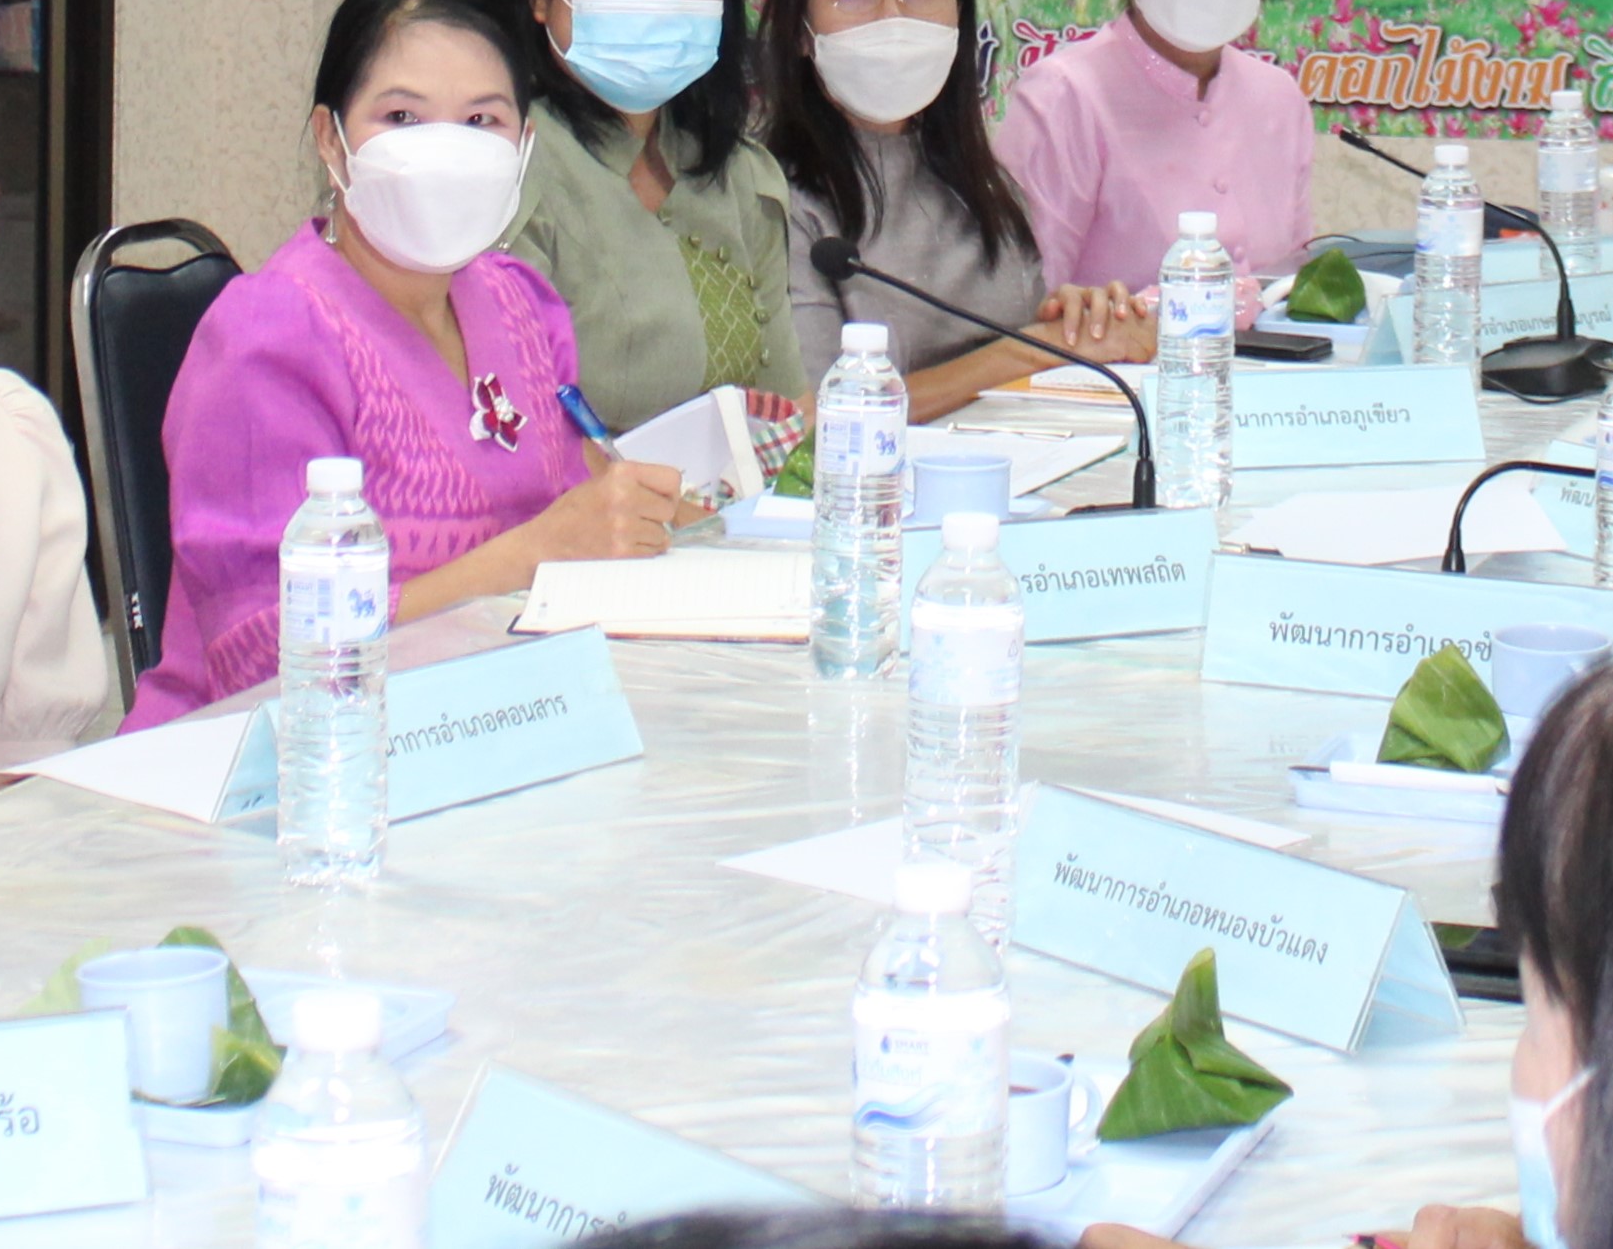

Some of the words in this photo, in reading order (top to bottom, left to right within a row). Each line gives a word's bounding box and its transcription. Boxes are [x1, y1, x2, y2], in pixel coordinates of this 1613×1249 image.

[1299, 20, 1576, 111] ดอกไม้งาม
[1235, 403, 1412, 432] นาการอำเภอภูเขียว
[1020, 554, 1187, 594] รอำเภอเทพสถิต
[385, 693, 569, 759] นาการอำเภอคอนสาร
[1053, 852, 1329, 965] พัฒนาการอำเภอหนองบัวแดง
